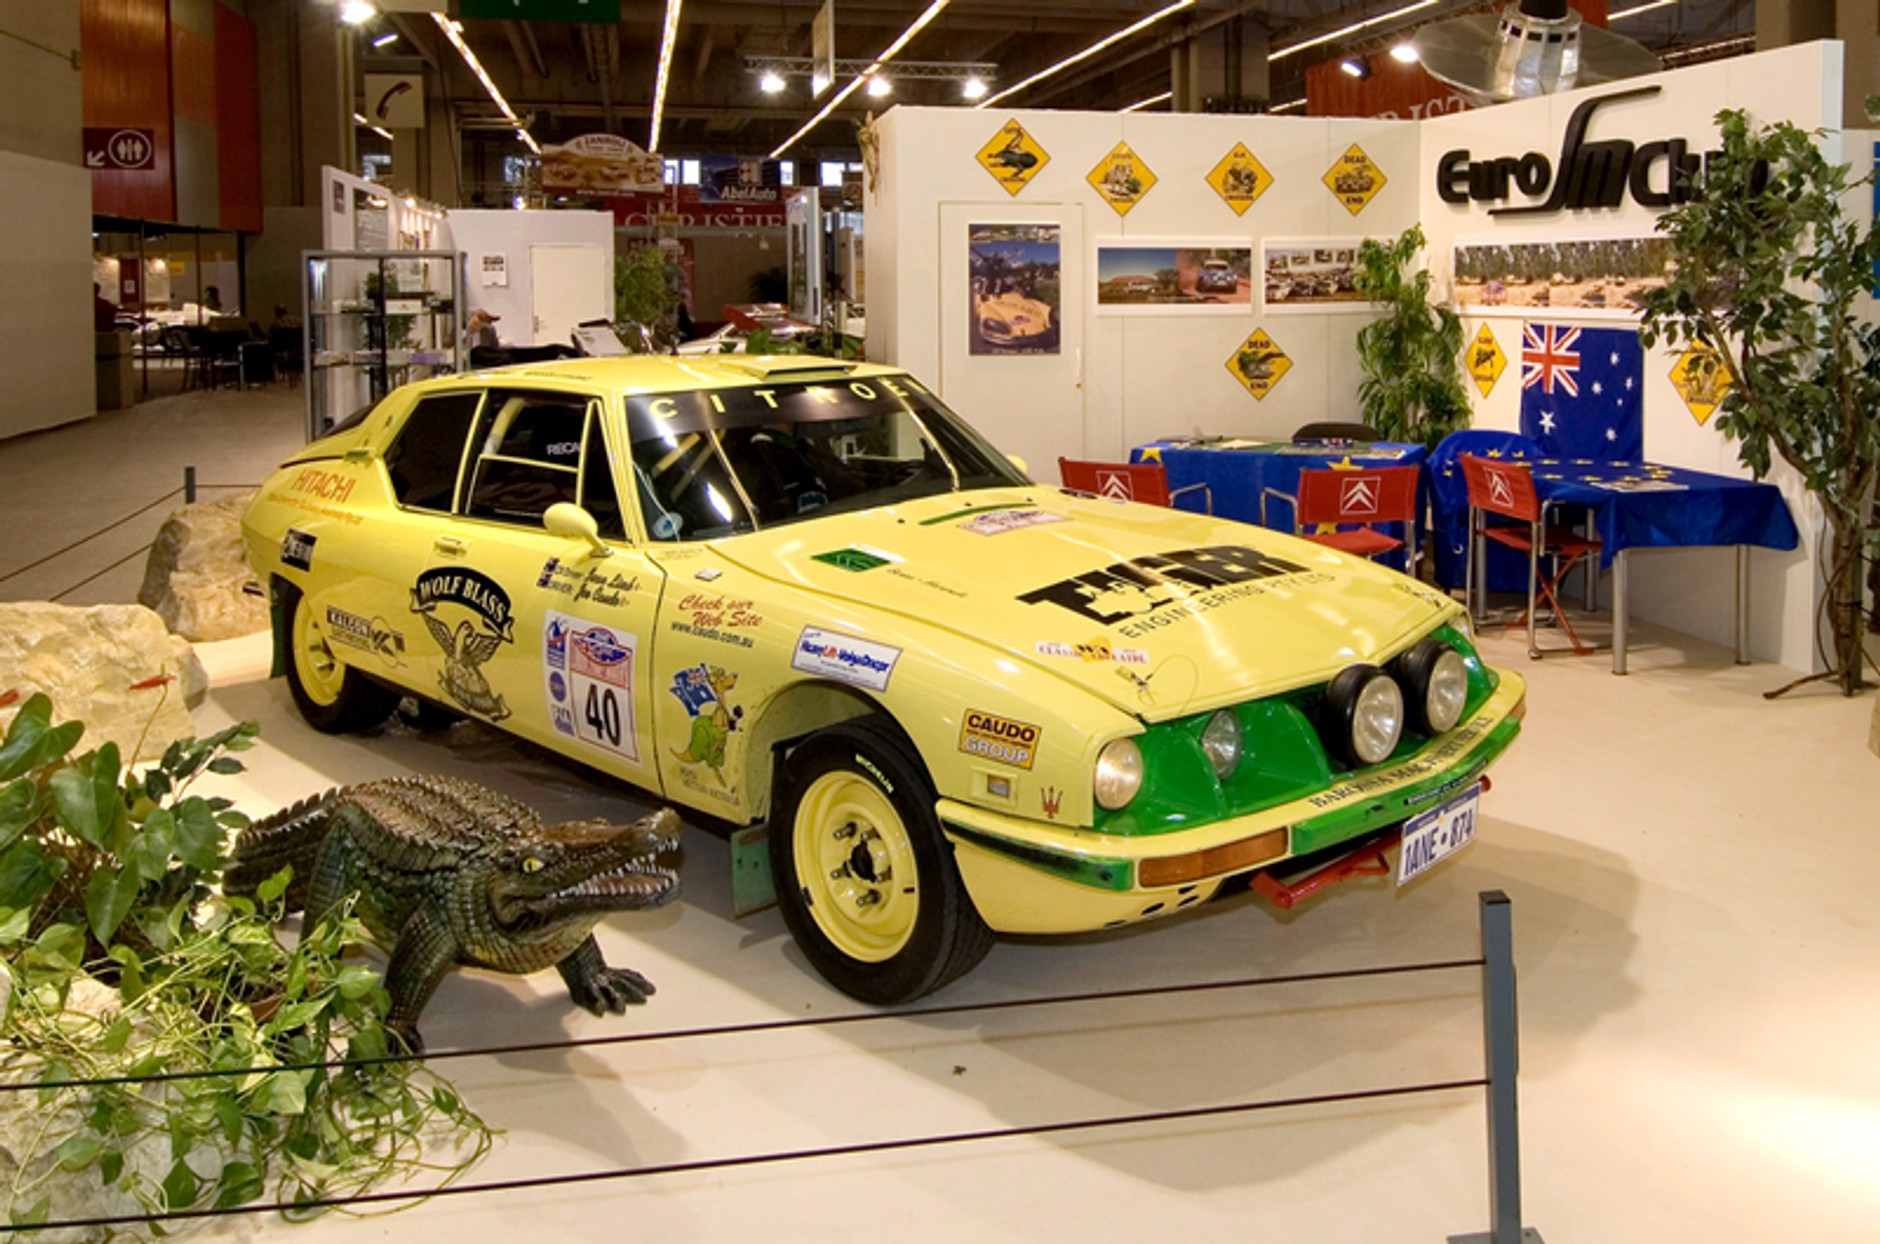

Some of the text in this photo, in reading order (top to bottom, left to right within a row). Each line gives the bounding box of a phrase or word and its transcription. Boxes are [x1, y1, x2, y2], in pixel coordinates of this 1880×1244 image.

[291, 469, 356, 504] HITACHI
[420, 575, 507, 622] WOLF BLASS
[679, 593, 725, 610] Check
[693, 610, 763, 628] Web Site
[586, 684, 621, 747] 40
[968, 714, 1036, 742] CAUDO
[963, 735, 1029, 763] GROUP
